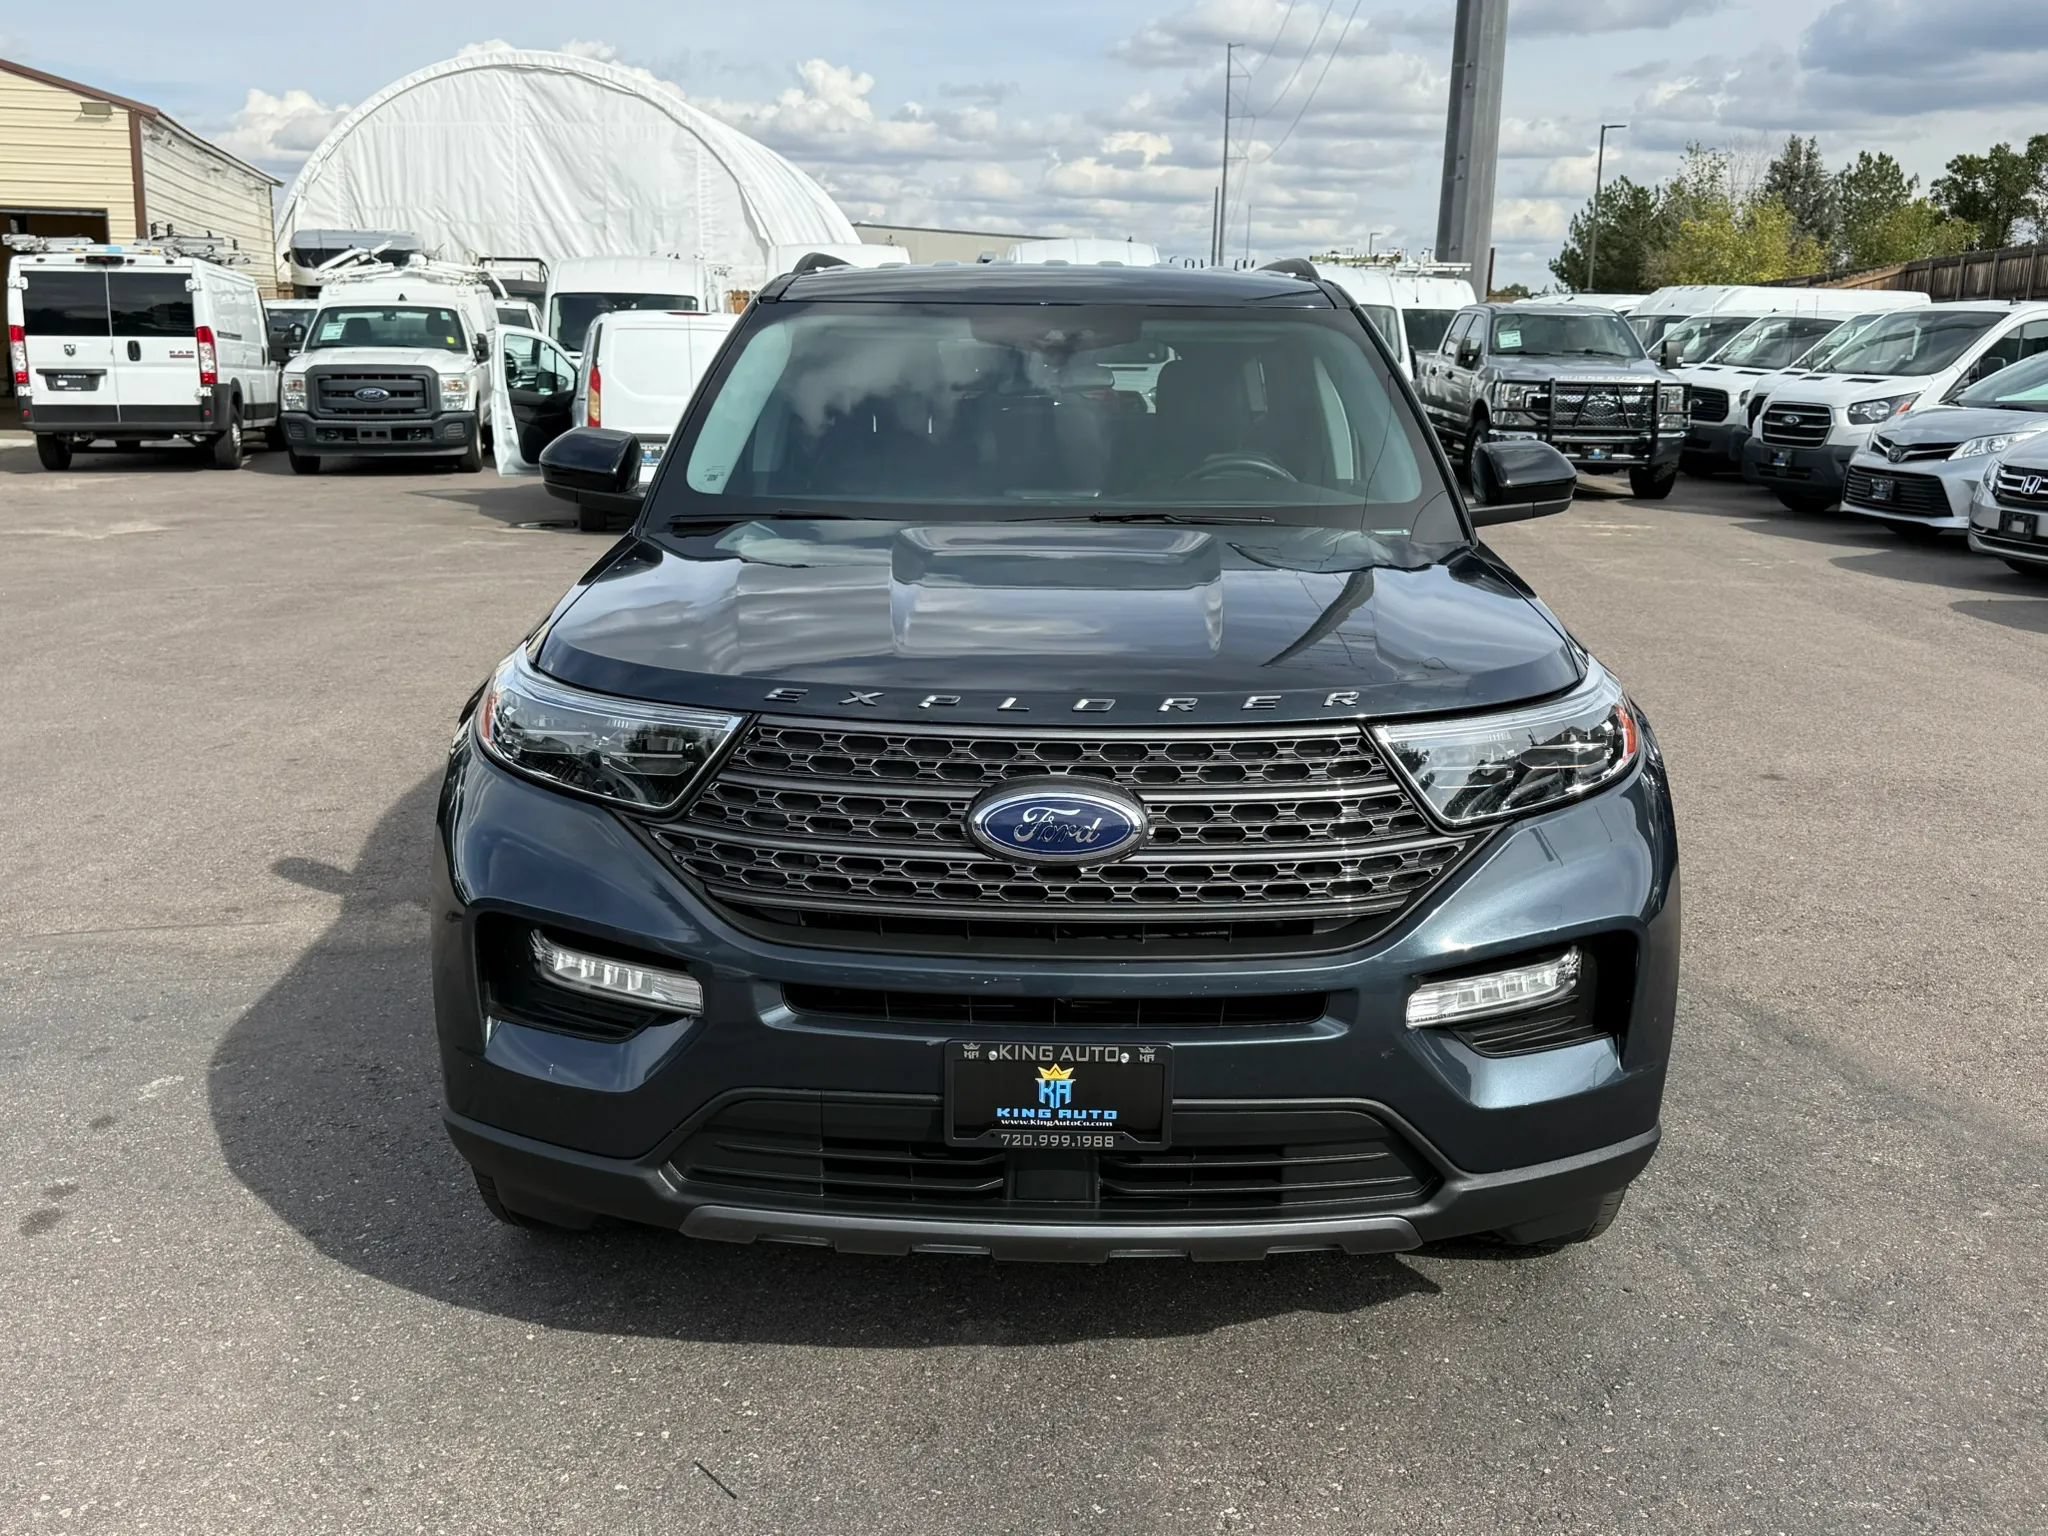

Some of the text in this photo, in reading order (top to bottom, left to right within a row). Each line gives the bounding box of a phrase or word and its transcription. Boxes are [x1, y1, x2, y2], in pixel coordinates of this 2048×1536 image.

[764, 687, 1360, 712] EXPLORER
[1013, 806, 1103, 844] Ford
[999, 1044, 1120, 1062] KING AUTO
[996, 1107, 1118, 1120] KING AUTO
[1000, 1118, 1113, 1127] www.KingAutoCo.com
[1000, 1134, 1114, 1148] 720.999.1988
